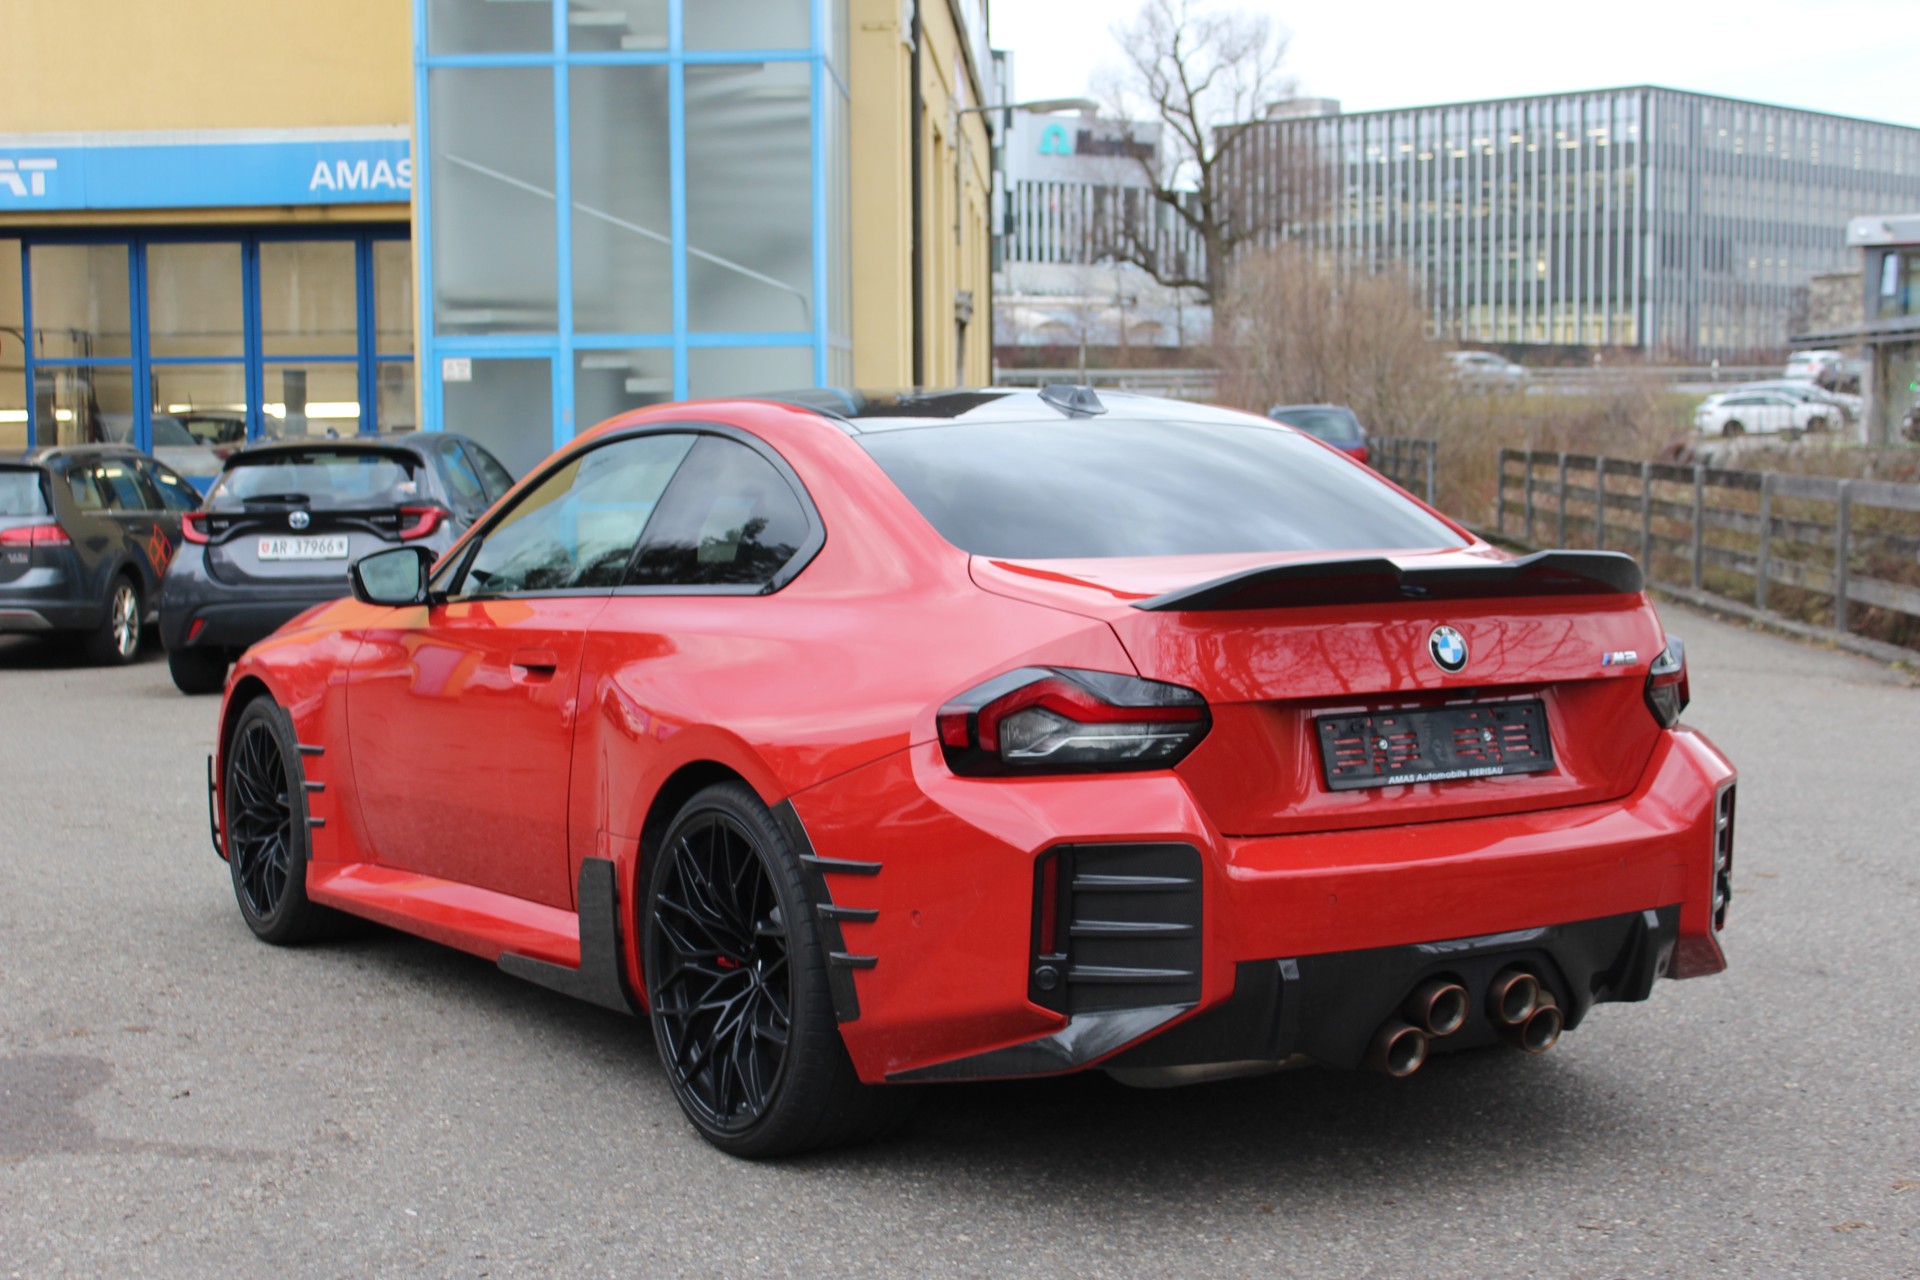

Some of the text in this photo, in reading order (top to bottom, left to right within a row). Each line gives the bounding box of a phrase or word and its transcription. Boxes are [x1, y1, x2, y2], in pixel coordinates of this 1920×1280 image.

[309, 159, 412, 191] AMAS
[295, 540, 334, 554] 37966
[1388, 766, 1504, 784] AMAS Automobile HERISAU
